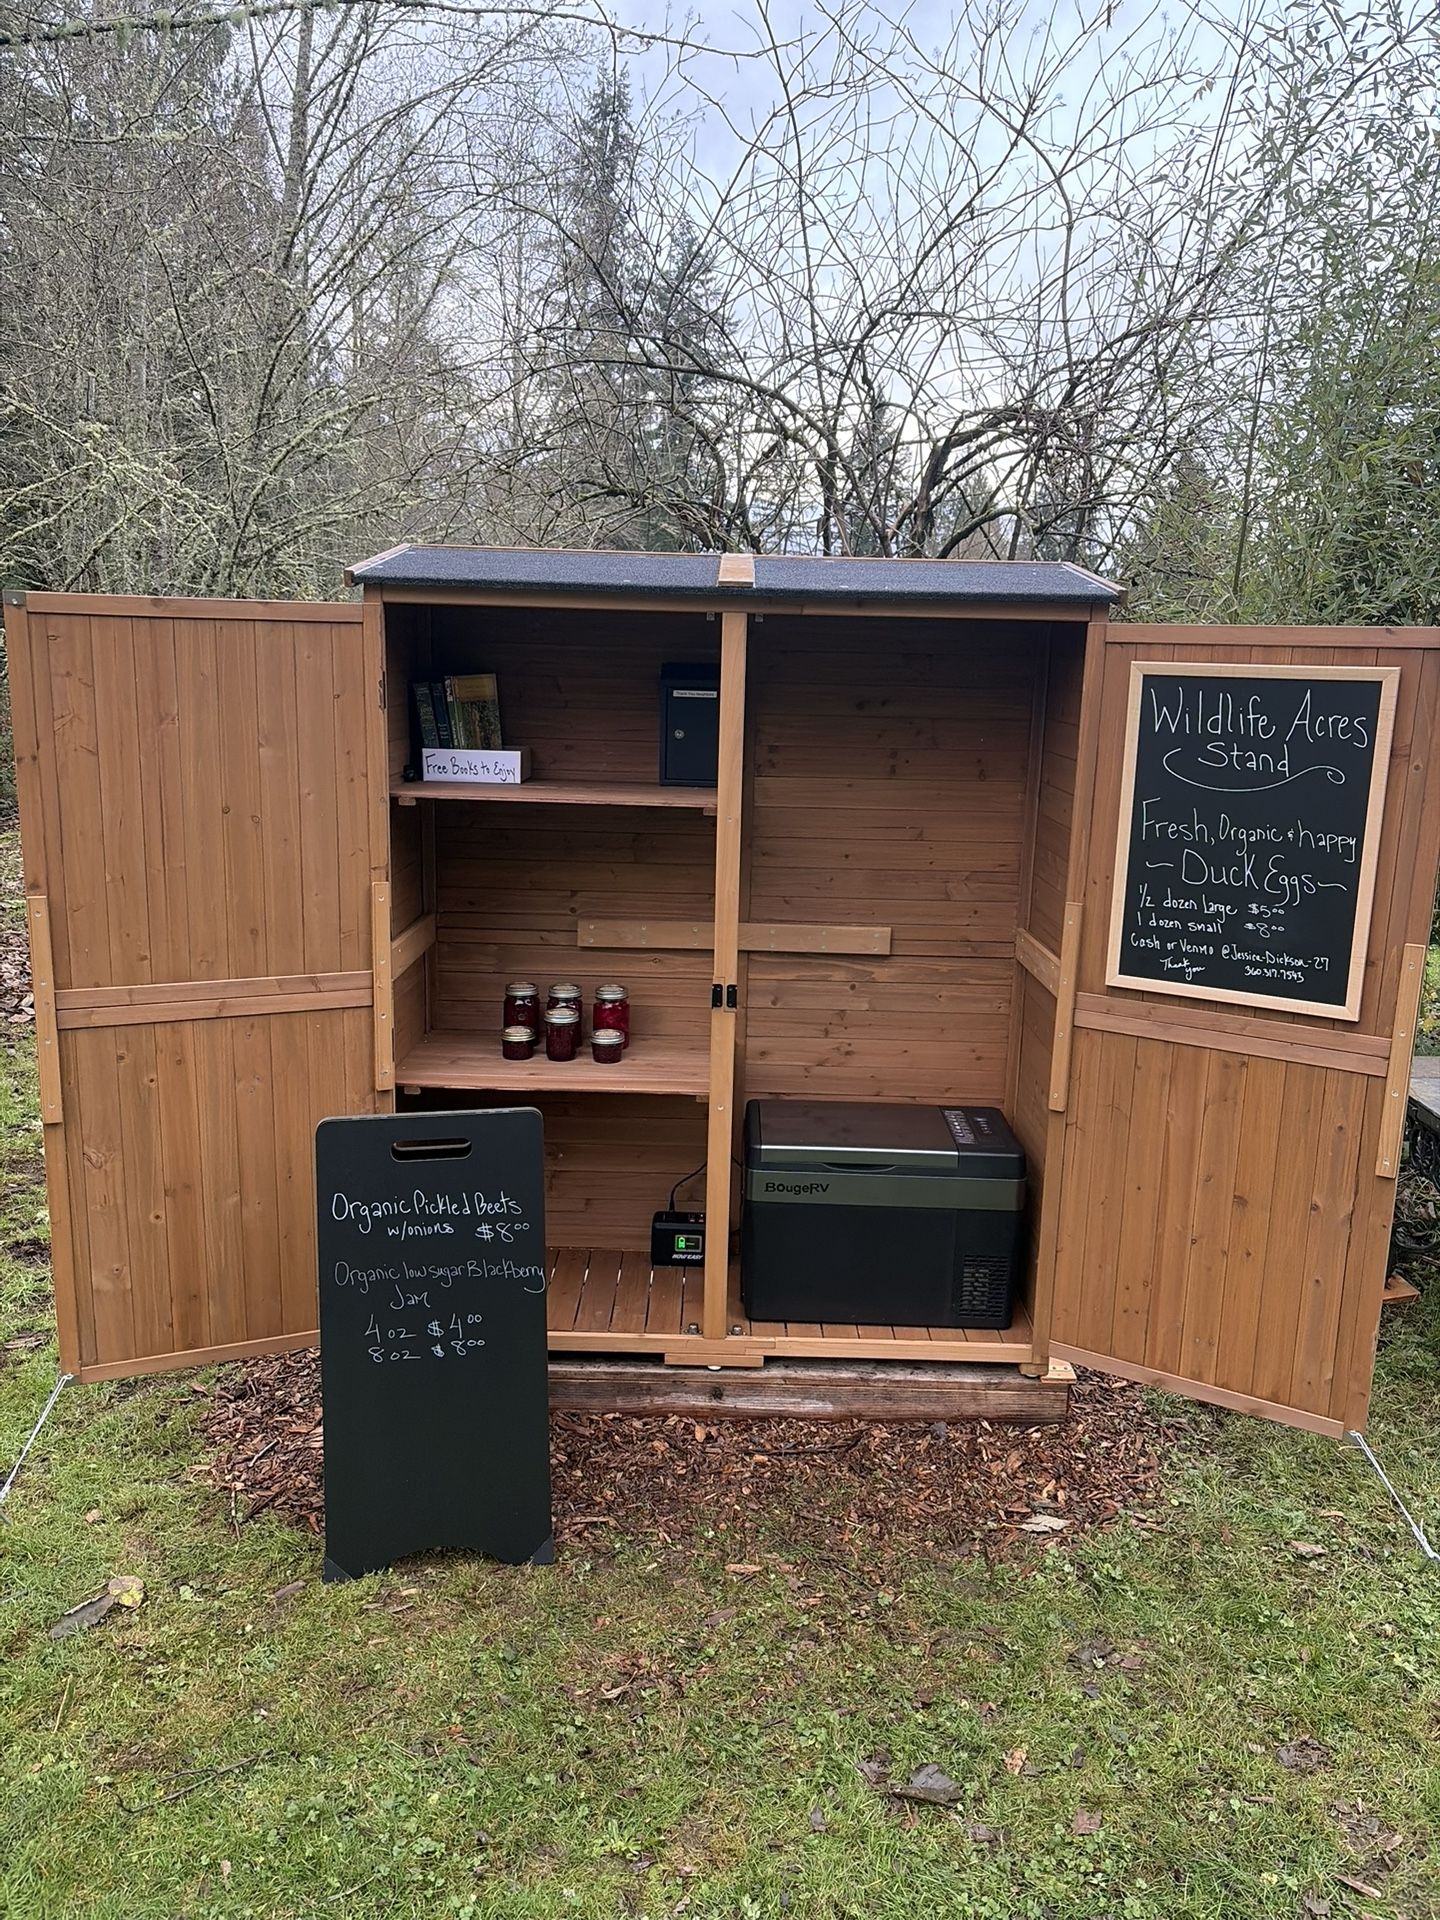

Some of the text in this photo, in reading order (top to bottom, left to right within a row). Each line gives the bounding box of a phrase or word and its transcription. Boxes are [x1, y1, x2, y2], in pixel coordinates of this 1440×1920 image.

[1151, 687, 1368, 748] Wildlife Acres
[425, 753, 516, 782] Free Books to Enjoy
[1198, 741, 1290, 777] Stand
[1142, 797, 1215, 845] Fresh,
[1218, 813, 1283, 856] Organic
[1297, 819, 1357, 863] happy
[1182, 848, 1316, 906] Duck Eggs
[1163, 887, 1198, 910] dozen
[1137, 911, 1142, 926] 1
[1149, 912, 1182, 930] dozen
[1188, 922, 1222, 934] small
[1130, 932, 1160, 950] Cash
[1167, 941, 1177, 950] or
[1160, 956, 1190, 971] Thank
[1185, 966, 1206, 981] you
[764, 1182, 830, 1195] BougeRV
[332, 1189, 522, 1234] Organic Pickled Beets
[388, 1221, 455, 1241] w/onions
[334, 1261, 401, 1294] Organic
[429, 1263, 465, 1288] sugar
[467, 1257, 546, 1294] Blackberry
[389, 1284, 431, 1310] Jam
[364, 1313, 381, 1343] 4
[388, 1327, 417, 1339] oz
[368, 1346, 384, 1363] 8
[390, 1350, 422, 1361] oz
